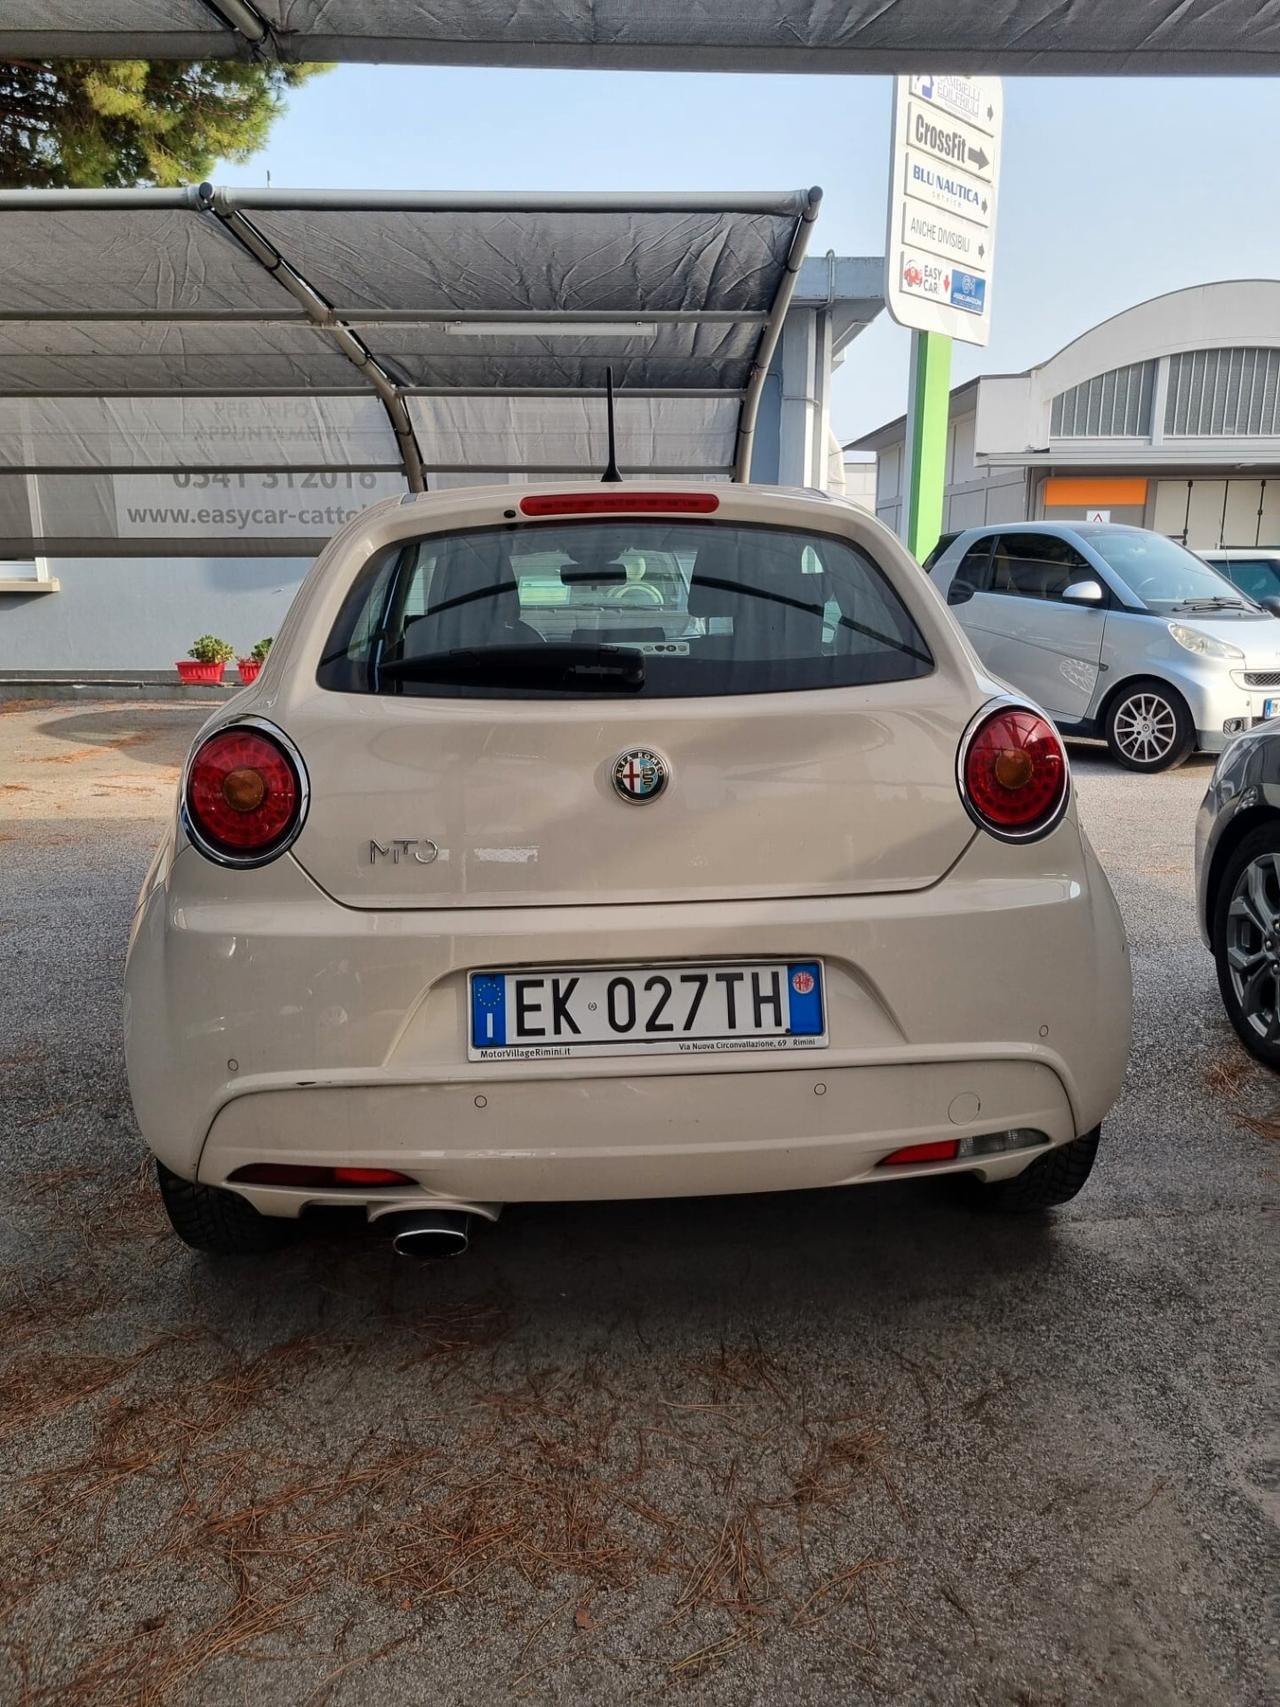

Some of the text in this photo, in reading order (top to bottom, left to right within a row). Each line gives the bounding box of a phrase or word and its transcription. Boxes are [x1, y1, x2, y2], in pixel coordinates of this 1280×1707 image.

[915, 113, 967, 164] CrossFit
[912, 164, 979, 206] BLU NAUTICA
[910, 217, 971, 253] ANCHE DIVISIBILI
[924, 264, 943, 281] EASY
[923, 279, 940, 295] CAR
[516, 971, 783, 1037] EK 027TH
[480, 1047, 571, 1059] MotorVillageRimini.it
[679, 1037, 816, 1051] Via Nuova Circonvallazione, 69 Rimini
